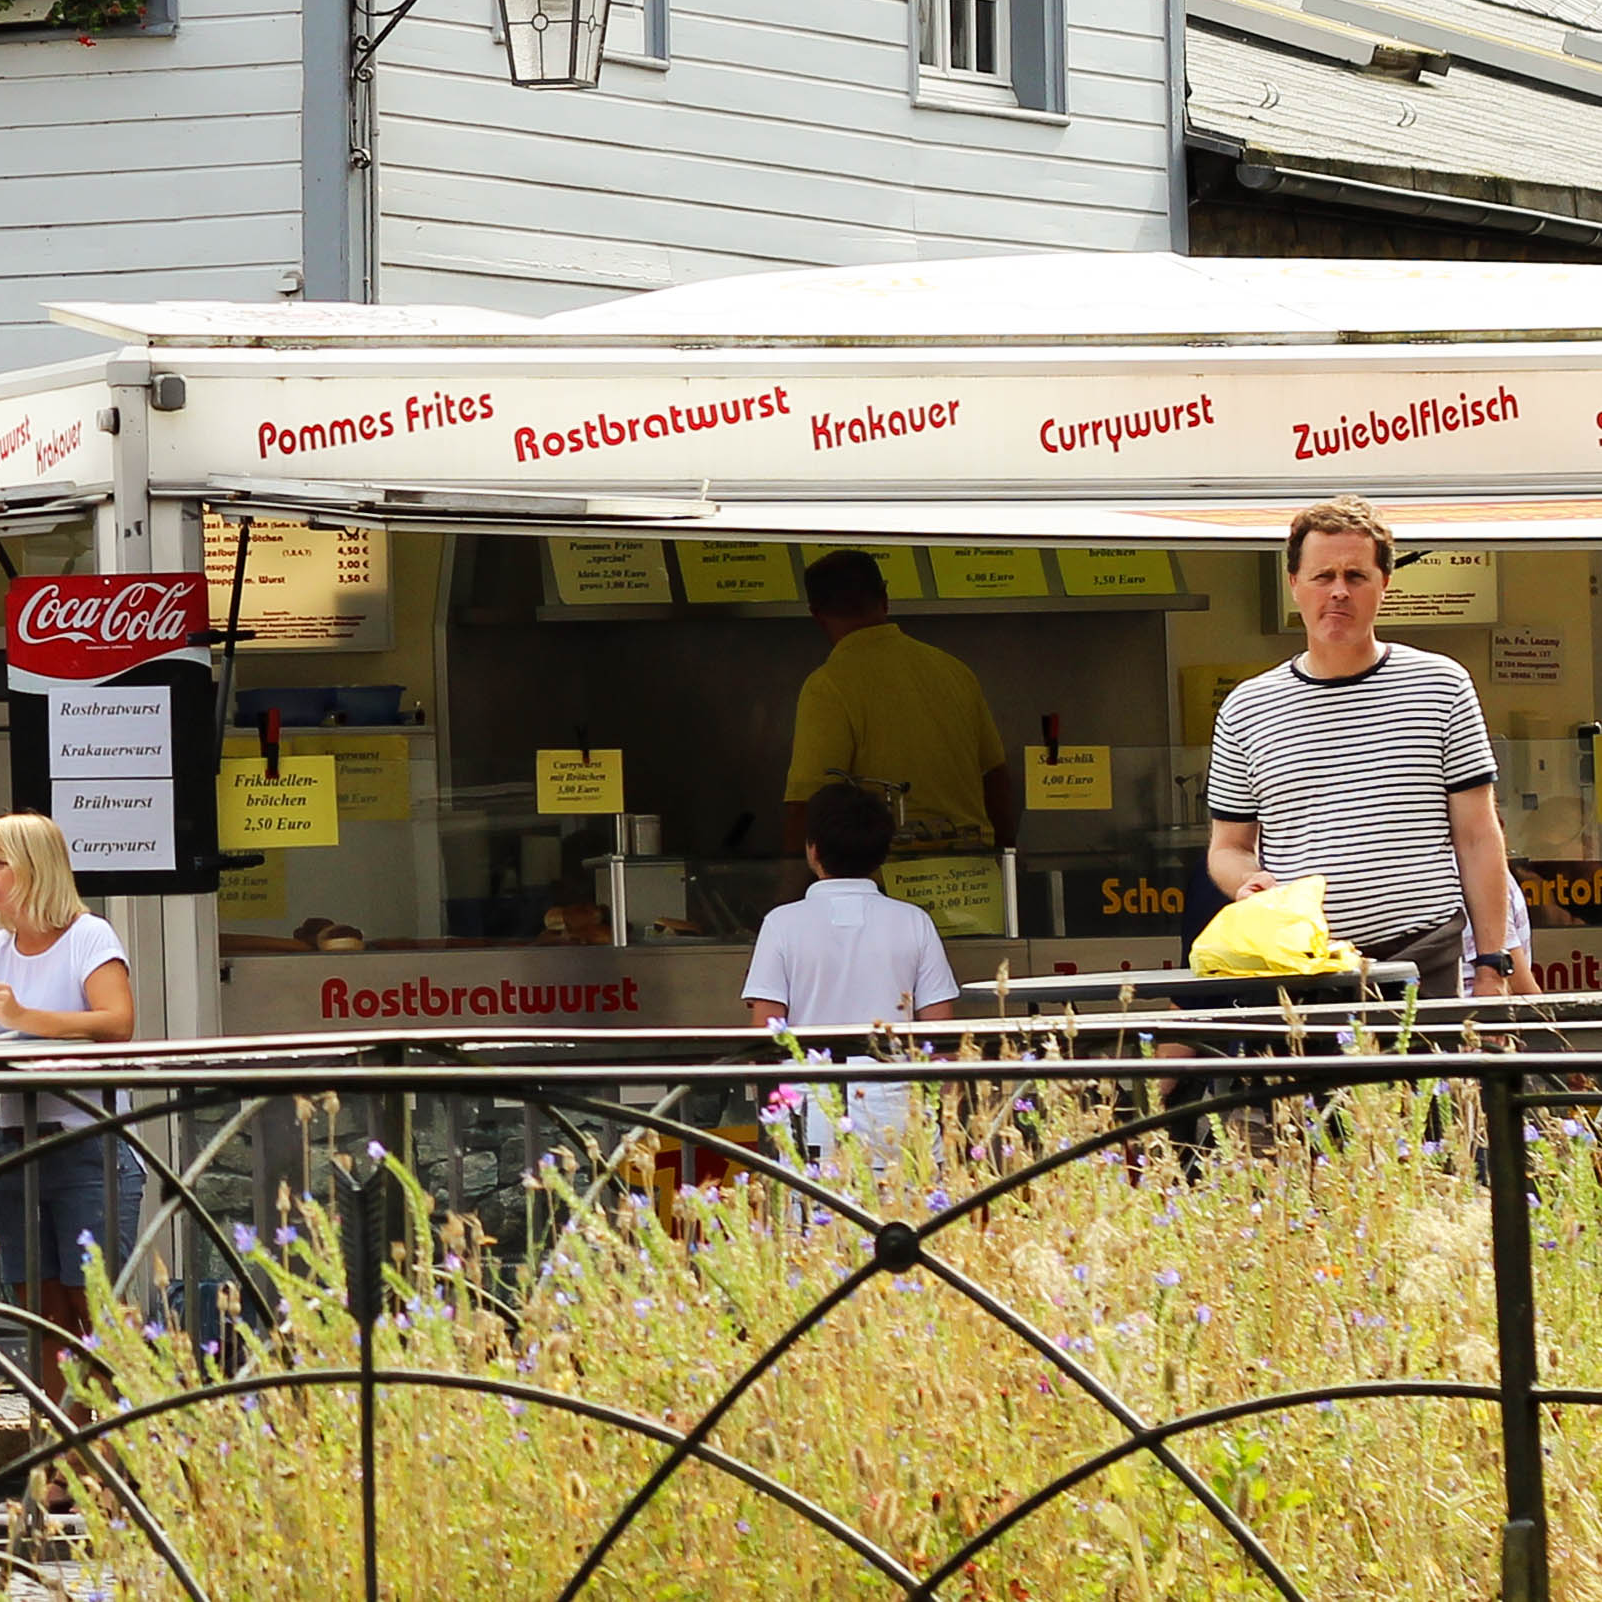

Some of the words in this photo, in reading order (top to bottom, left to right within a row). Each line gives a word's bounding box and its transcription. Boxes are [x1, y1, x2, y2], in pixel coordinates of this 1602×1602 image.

[258, 408, 395, 460] Pommes
[405, 391, 495, 434] Frites
[513, 385, 791, 463] Rostbratwurst
[810, 397, 961, 452] Krakauer
[1038, 392, 1215, 454] Currywurst
[1291, 384, 1520, 462] Zwiebelfleisch
[36, 419, 82, 477] Krakauer
[337, 560, 360, 569] 3,00
[338, 574, 361, 583] 3,50
[17, 581, 197, 645] Coca-Cola
[60, 702, 162, 717] Rostbratwurst
[60, 744, 163, 758] Krakauerwurst
[552, 760, 602, 771] Currywrst
[1067, 774, 1094, 785] Euro
[72, 794, 154, 810] Brühwurst
[245, 793, 307, 807] brötchen
[243, 817, 273, 832] 2,50
[276, 817, 312, 831] Euro
[71, 838, 157, 856] Currywurst
[321, 975, 640, 1020] Rostbratwurst
